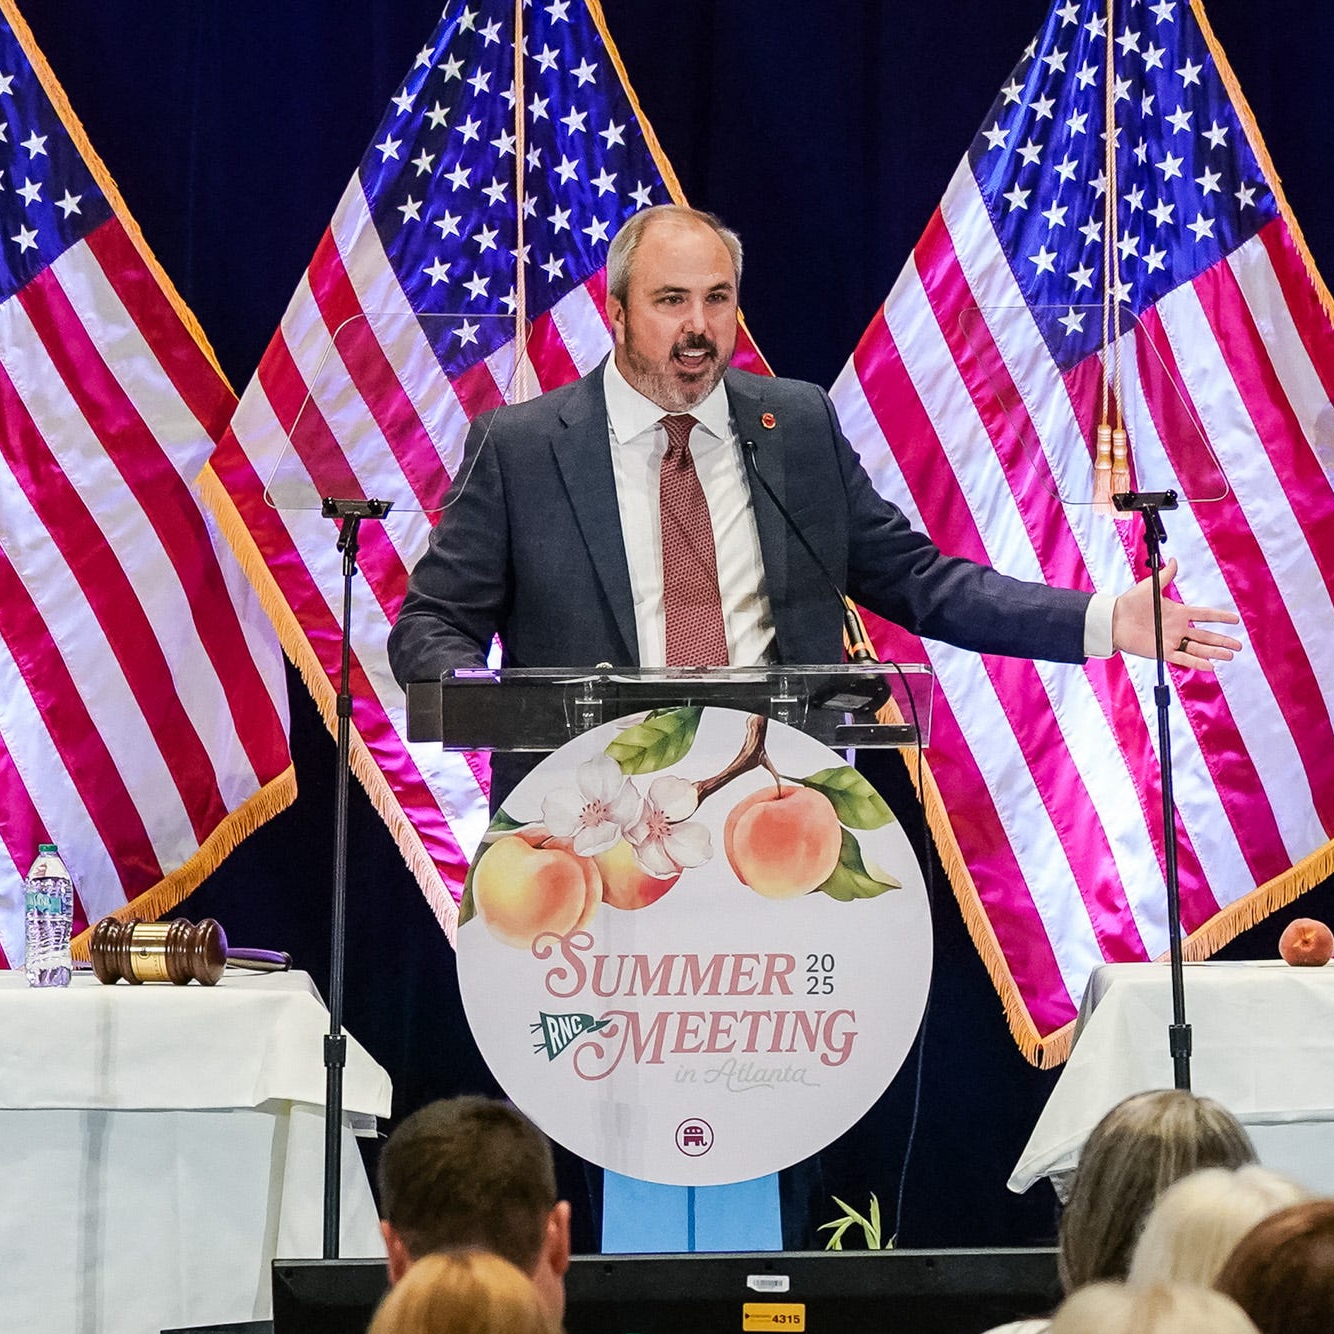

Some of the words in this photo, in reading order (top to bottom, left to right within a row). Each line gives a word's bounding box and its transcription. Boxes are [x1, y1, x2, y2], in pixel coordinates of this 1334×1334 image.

[531, 931, 796, 999] SUMMER
[805, 953, 836, 973] 20
[805, 976, 835, 996] 25
[548, 1013, 584, 1048] RNC
[573, 1009, 858, 1081] MEETING
[674, 1062, 698, 1083] in
[704, 1058, 821, 1093] Atlanta
[771, 1314, 801, 1325] 4315
